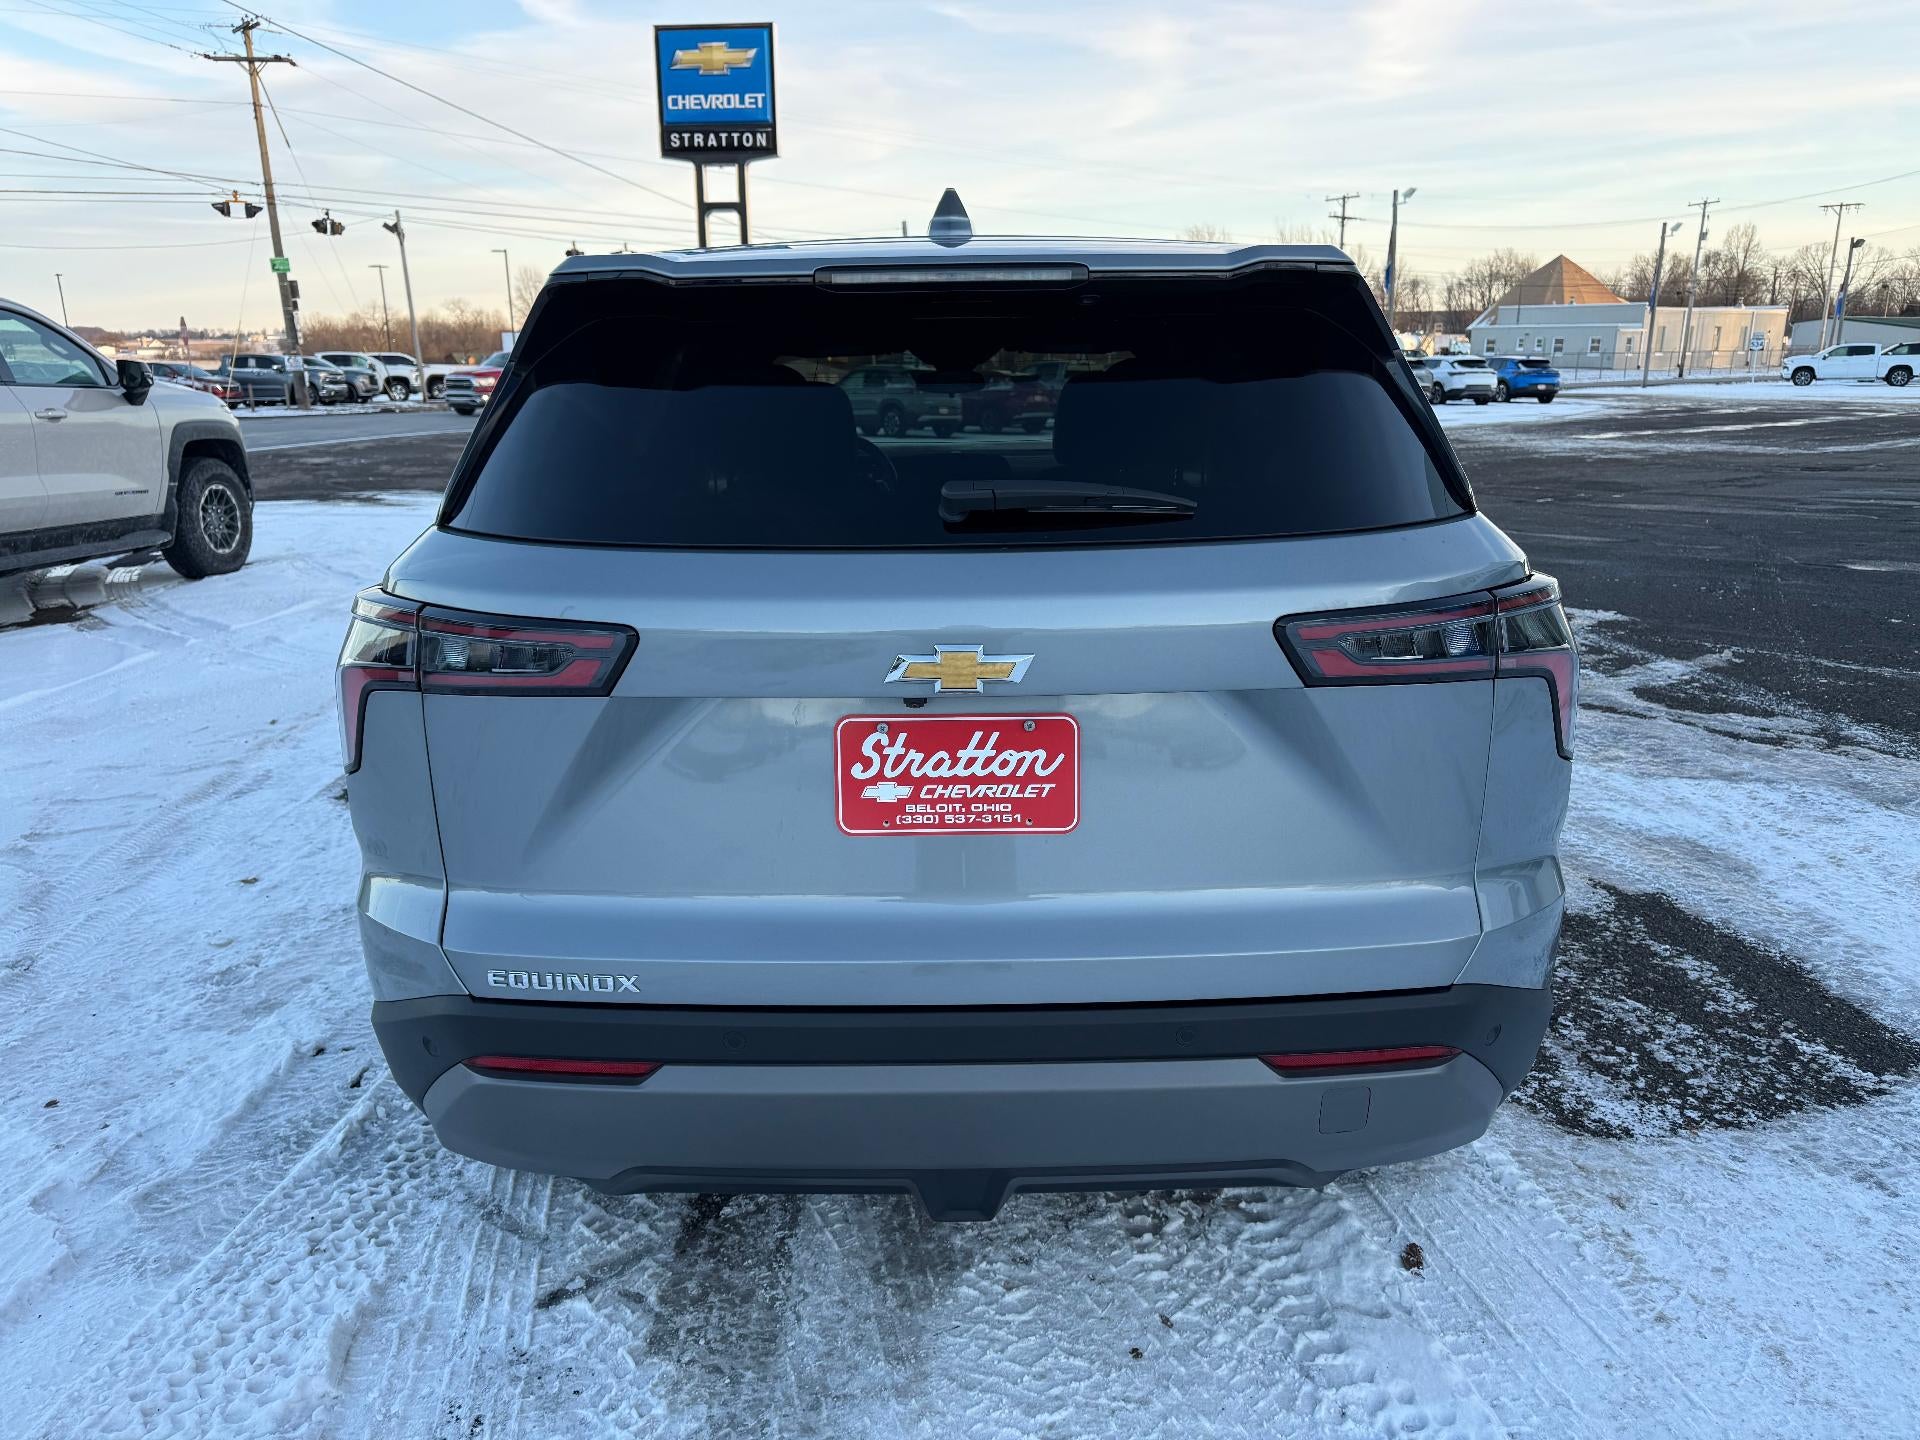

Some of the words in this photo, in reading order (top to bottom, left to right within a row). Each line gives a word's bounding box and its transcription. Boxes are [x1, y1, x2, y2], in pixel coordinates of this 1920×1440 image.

[667, 93, 765, 110] CHEVROLET
[670, 132, 767, 148] STRATTON
[850, 731, 1065, 780] Stratton
[919, 783, 1057, 799] CHEVROLET
[905, 804, 966, 813] BELOIT,
[971, 803, 1012, 813] OHIO
[895, 814, 940, 825] (330)
[944, 814, 1021, 824] 537-3151
[487, 969, 641, 994] EQUINOX
